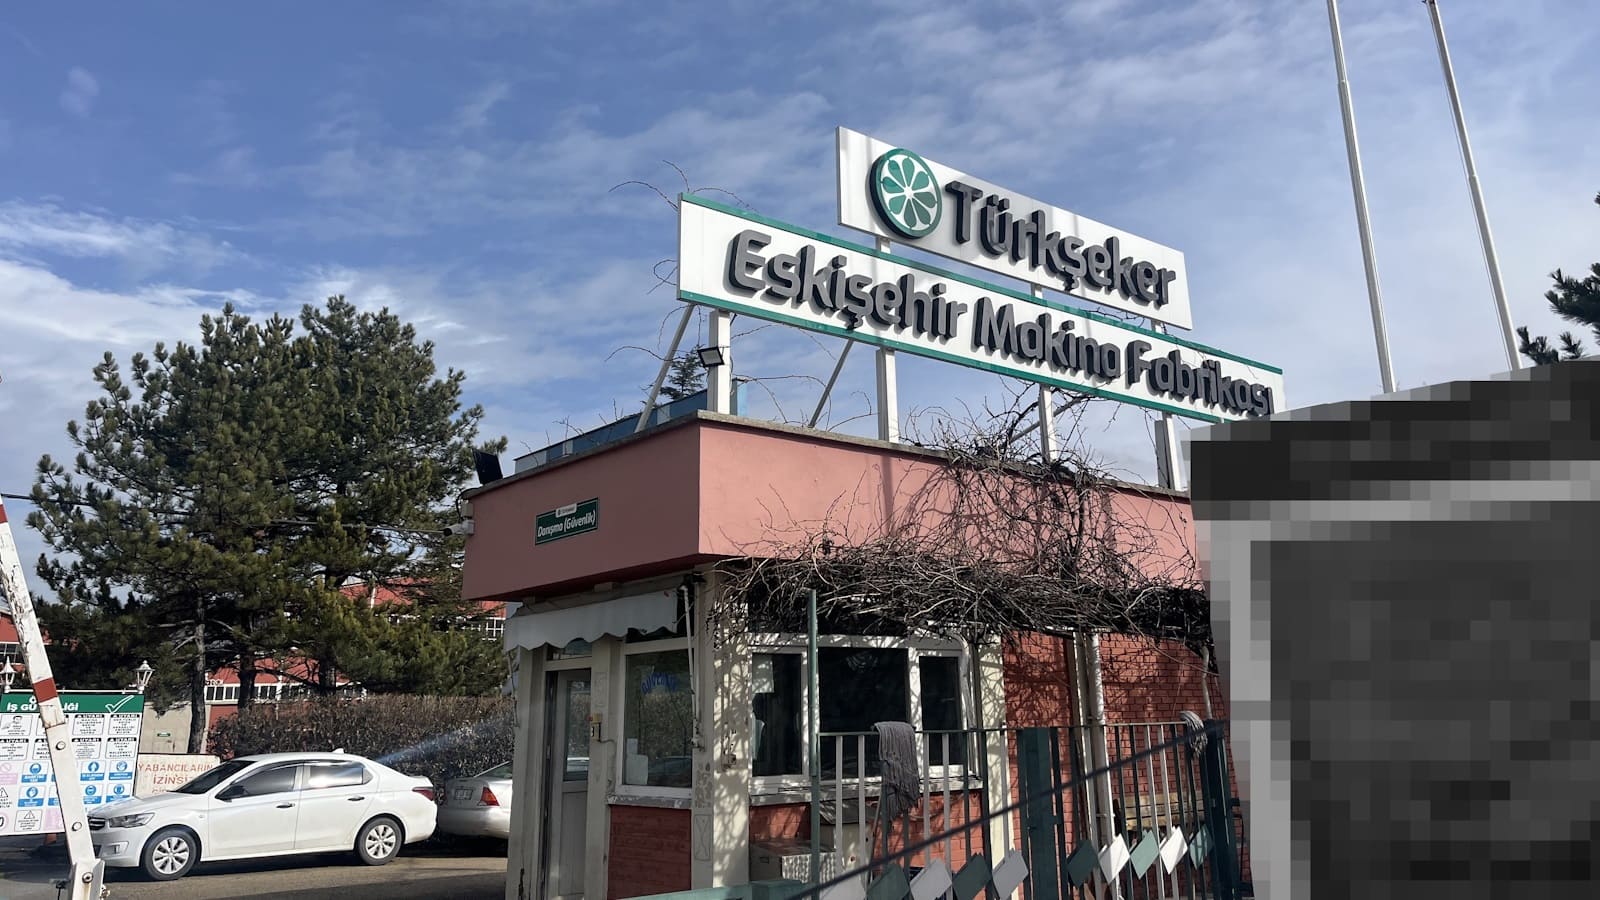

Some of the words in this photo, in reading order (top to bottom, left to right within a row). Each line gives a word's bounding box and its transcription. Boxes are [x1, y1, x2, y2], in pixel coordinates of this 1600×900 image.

[945, 180, 1177, 307] Türkşeker
[726, 229, 968, 339] Eskişehir
[972, 296, 1121, 378] Makina
[1126, 339, 1275, 416] Fabrikası
[537, 522, 563, 537] Danışma
[563, 510, 596, 532] (Güvenlik)
